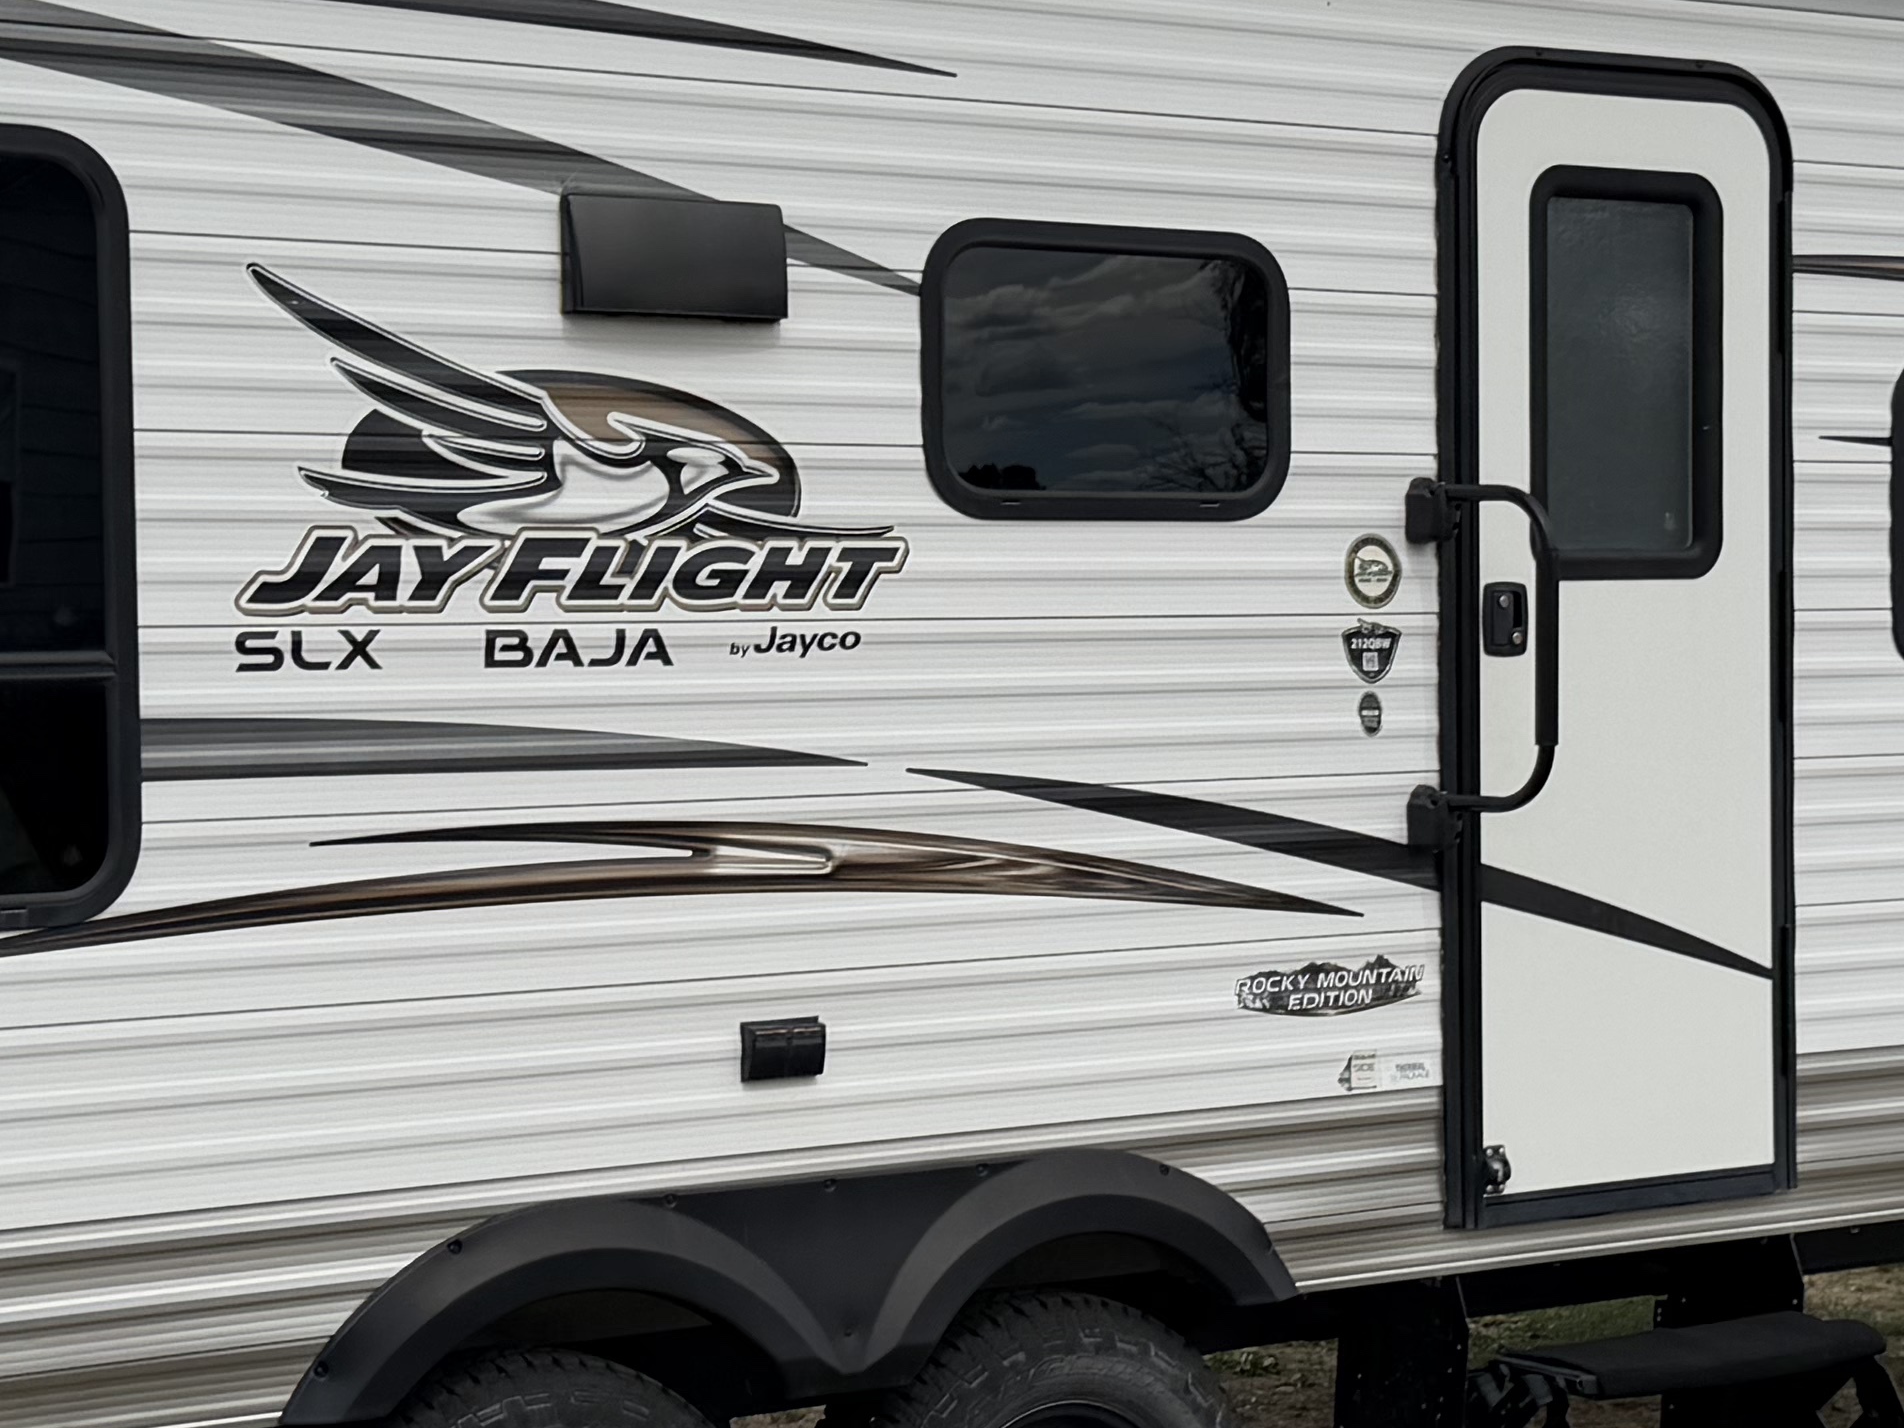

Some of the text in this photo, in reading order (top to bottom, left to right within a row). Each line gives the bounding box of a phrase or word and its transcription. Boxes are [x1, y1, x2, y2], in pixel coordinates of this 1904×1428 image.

[236, 527, 908, 614] JAY FLIGHT
[234, 626, 862, 672] SLX BAJA by Jayco
[1234, 964, 1425, 995] ROCKY MOUNTAIN
[1287, 988, 1373, 1011] EDITION
